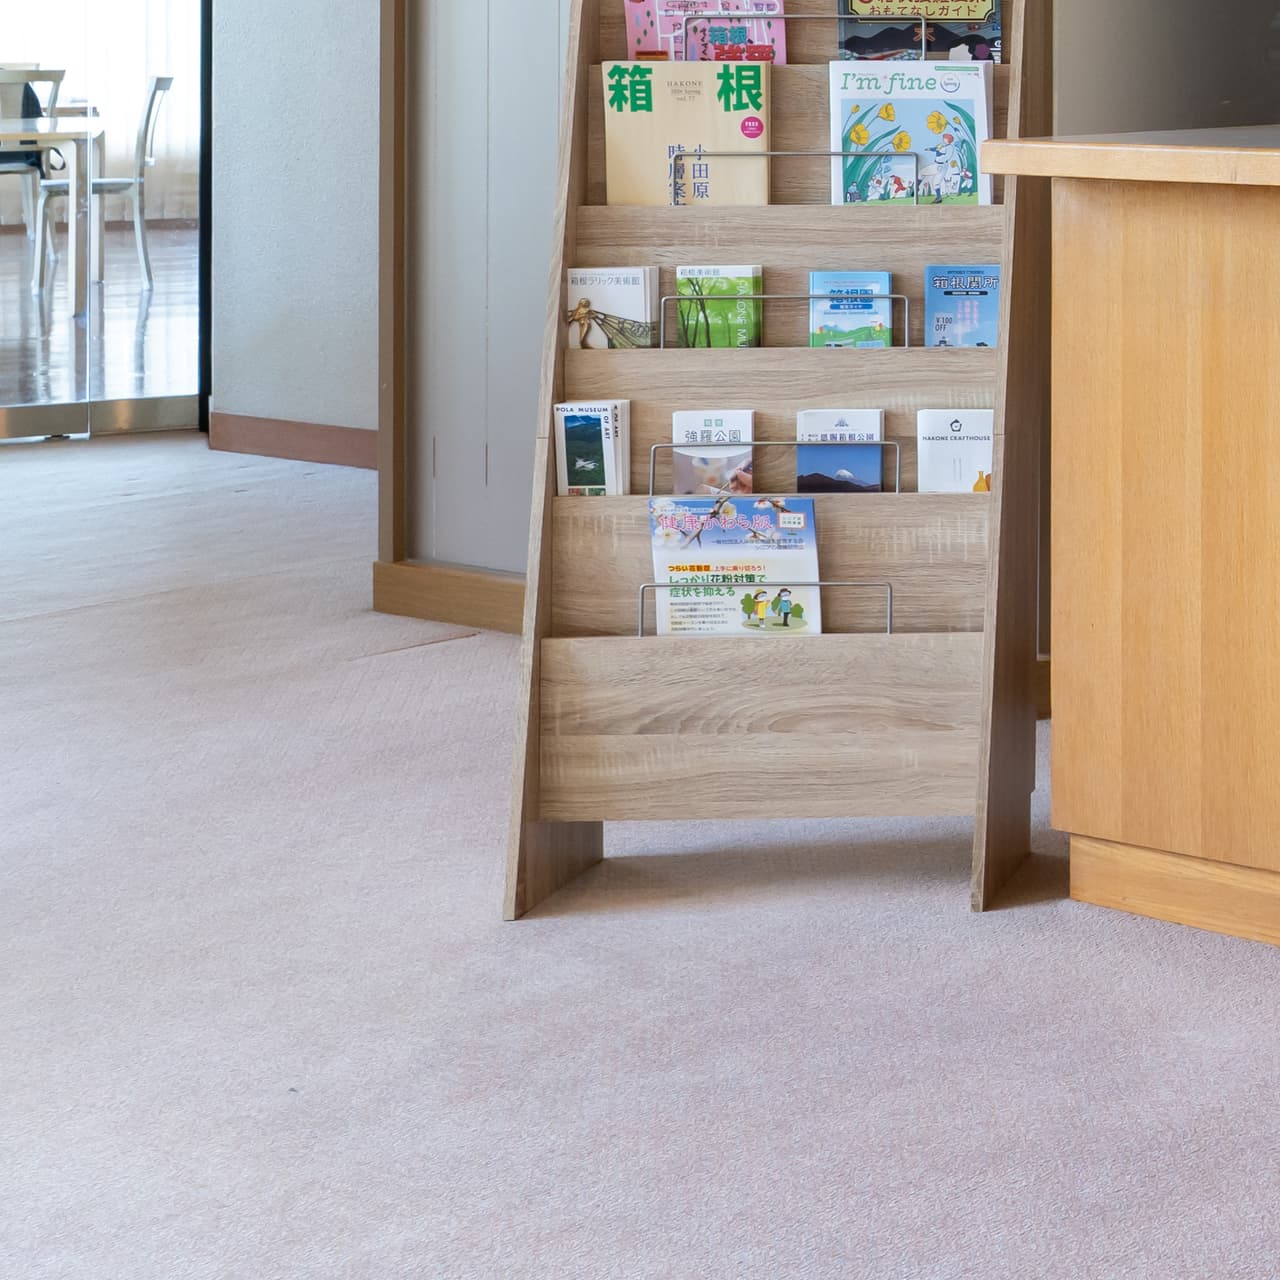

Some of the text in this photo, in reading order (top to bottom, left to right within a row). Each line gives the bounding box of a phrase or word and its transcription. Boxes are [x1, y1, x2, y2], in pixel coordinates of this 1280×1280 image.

[869, 5, 978, 17] おもてなしガイド
[840, 72, 937, 95] I'm fine
[570, 276, 641, 286] 箱根ラリック美術館
[658, 513, 773, 531] 健康かわら版
